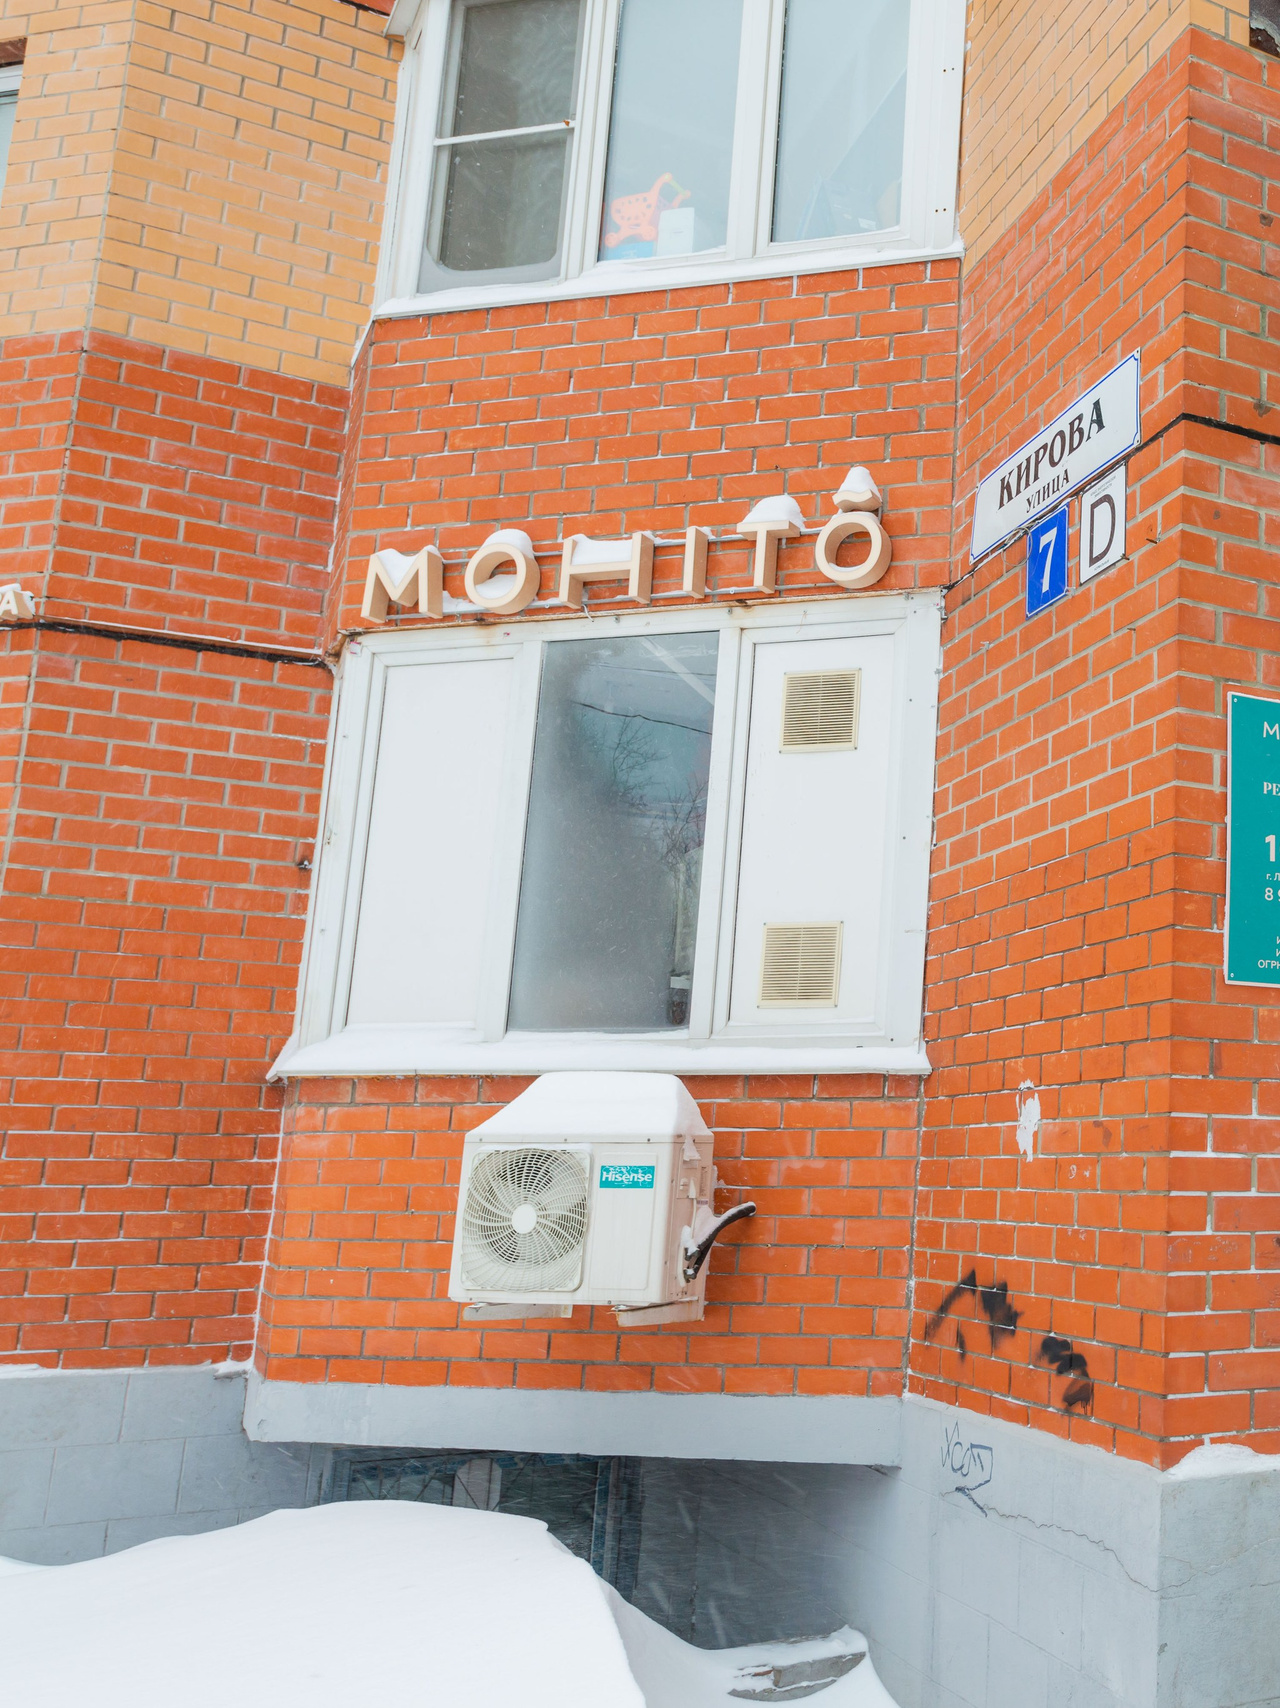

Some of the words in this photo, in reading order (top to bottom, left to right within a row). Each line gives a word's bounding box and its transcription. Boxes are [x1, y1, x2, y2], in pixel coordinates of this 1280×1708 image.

[998, 398, 1106, 510] КИРОВА
[1026, 469, 1070, 514] УЛИЦА
[1089, 493, 1117, 569] D
[1039, 526, 1058, 595] 7
[1264, 887, 1274, 901] 8
[1266, 873, 1272, 881] г.
[602, 1171, 653, 1182] Hisense
